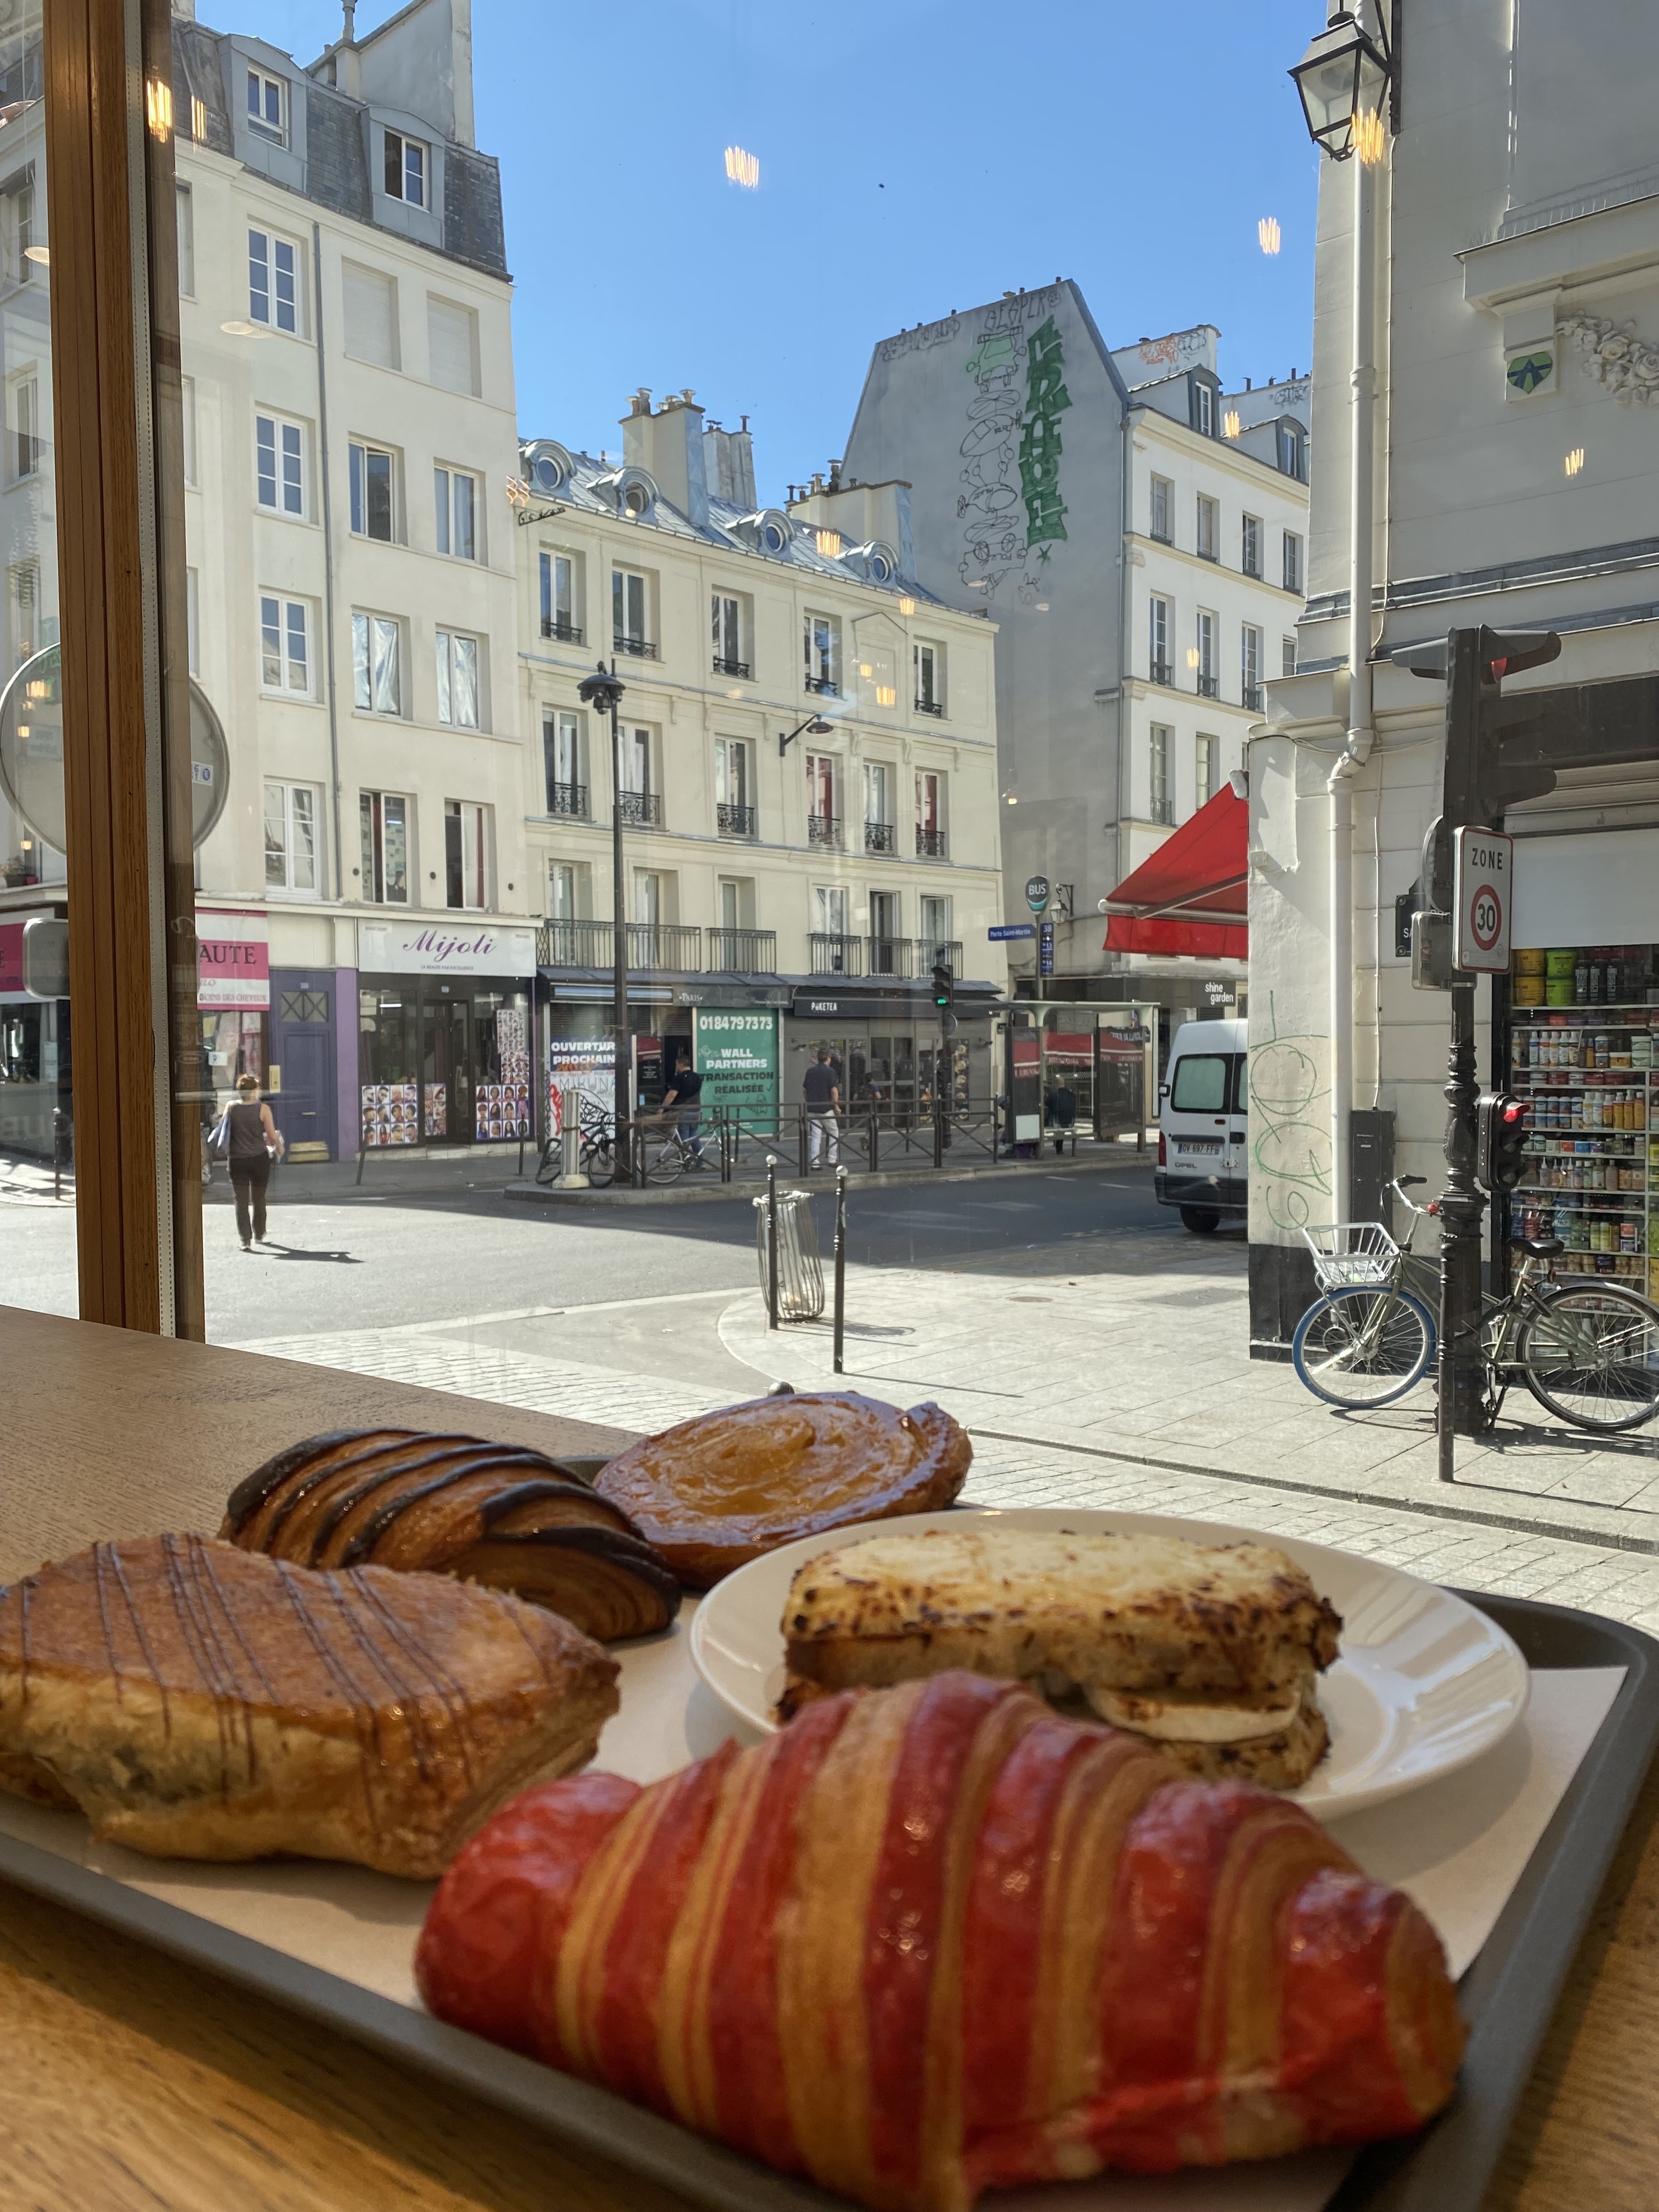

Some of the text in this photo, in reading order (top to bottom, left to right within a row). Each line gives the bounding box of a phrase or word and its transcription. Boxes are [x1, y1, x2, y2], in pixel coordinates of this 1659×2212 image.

[1471, 848, 1503, 871] ZONE
[1029, 884, 1046, 895] BUS
[1477, 904, 1496, 932] 30
[1003, 928, 1031, 936] Saint-Martin
[1043, 924, 1052, 933] 38
[403, 930, 498, 962] Mijoli
[1205, 981, 1223, 992] shine
[236, 994, 267, 1002] CHEVEUX
[1210, 992, 1234, 1005] garden
[721, 1048, 753, 1058] WALL
[706, 1059, 768, 1069] PARTNERS
[702, 1071, 774, 1082] TRANSACTION
[715, 1084, 764, 1094] RÉALISÉE
